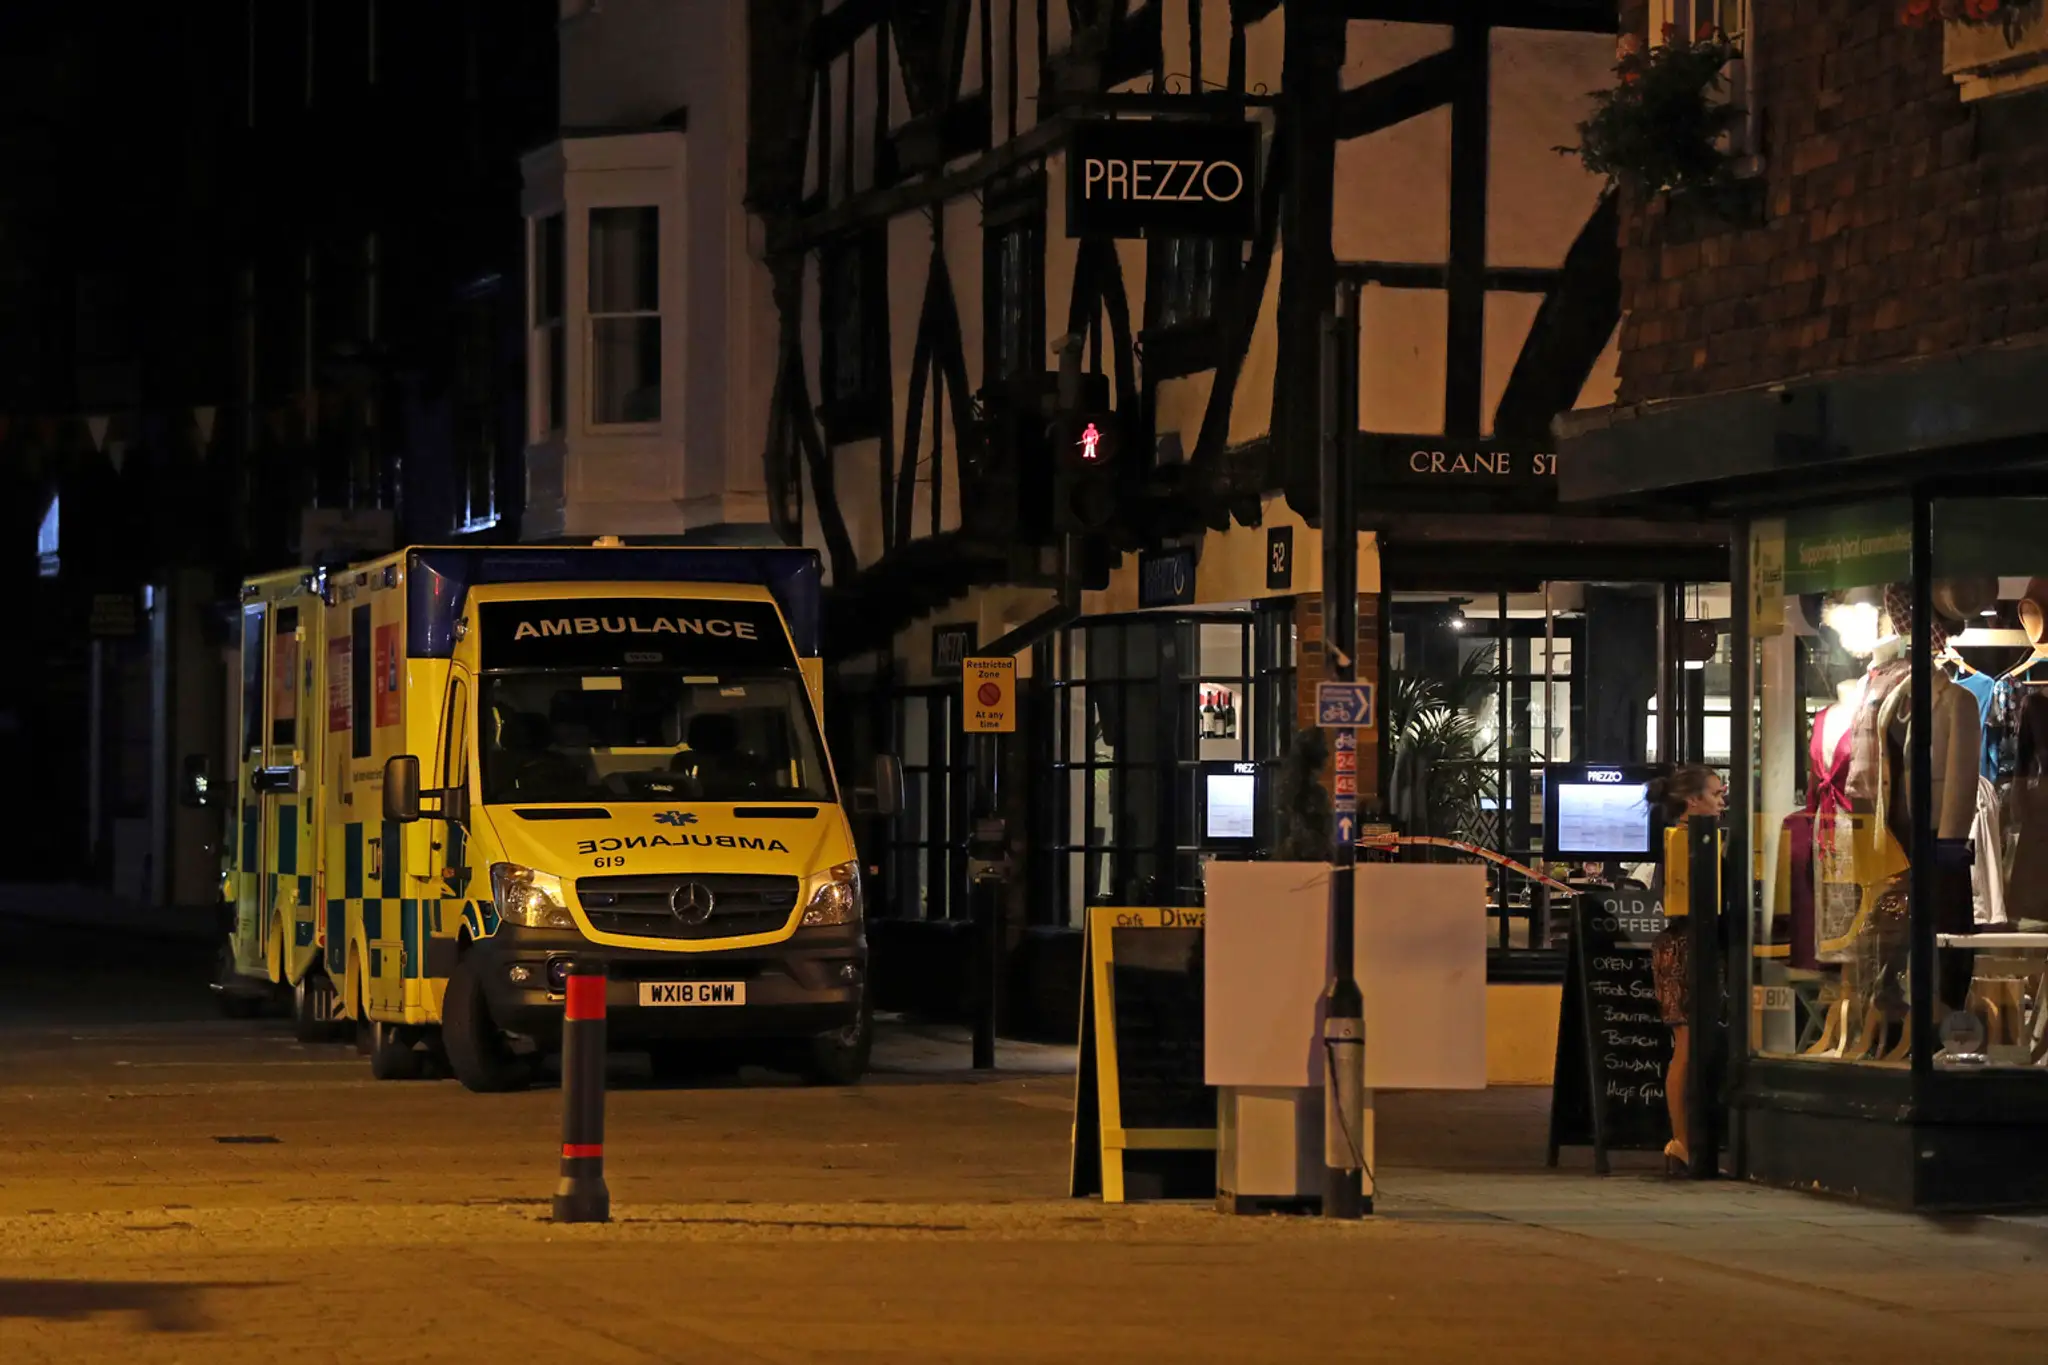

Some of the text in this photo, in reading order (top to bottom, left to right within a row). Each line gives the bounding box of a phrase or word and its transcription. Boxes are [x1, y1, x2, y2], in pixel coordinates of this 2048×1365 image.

[1085, 158, 1244, 203] PREZZO
[1409, 450, 1558, 475] CRANE ST
[1272, 541, 1286, 574] 52
[513, 616, 758, 641] AMBULANCE
[966, 660, 1013, 669] Restricted
[978, 670, 1000, 679] Zone
[976, 711, 1004, 720] At any
[1587, 770, 1623, 783] PREZZO
[593, 856, 626, 868] 619
[1603, 898, 1645, 914] OLD
[1591, 917, 1661, 932] COFFEE
[1593, 956, 1634, 972] OPEN
[651, 984, 734, 1003] WX18 GWW
[1600, 1029, 1659, 1047] BEACH
